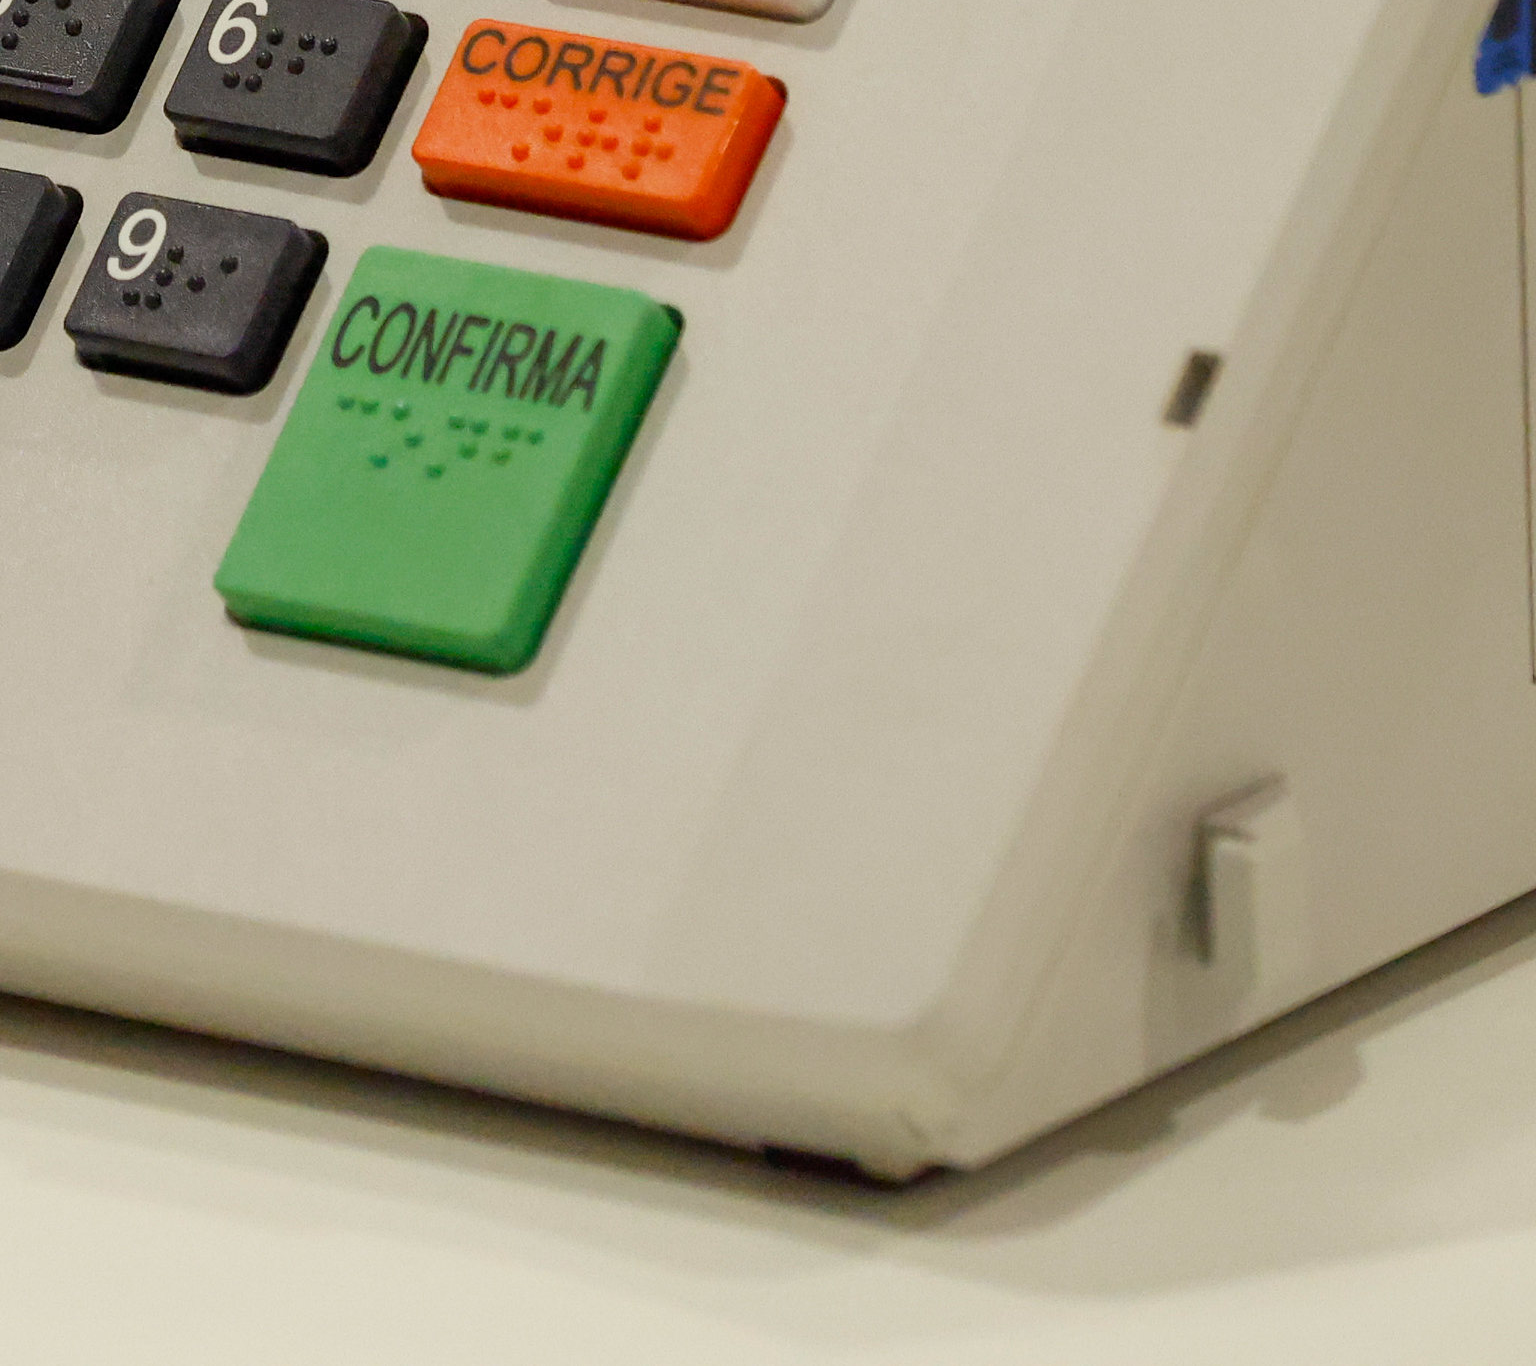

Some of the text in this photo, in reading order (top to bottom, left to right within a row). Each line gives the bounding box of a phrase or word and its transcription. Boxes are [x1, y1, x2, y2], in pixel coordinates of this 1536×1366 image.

[461, 27, 740, 117] CORRIGE
[106, 208, 168, 280] 9
[331, 295, 609, 412] CONFIRMA
